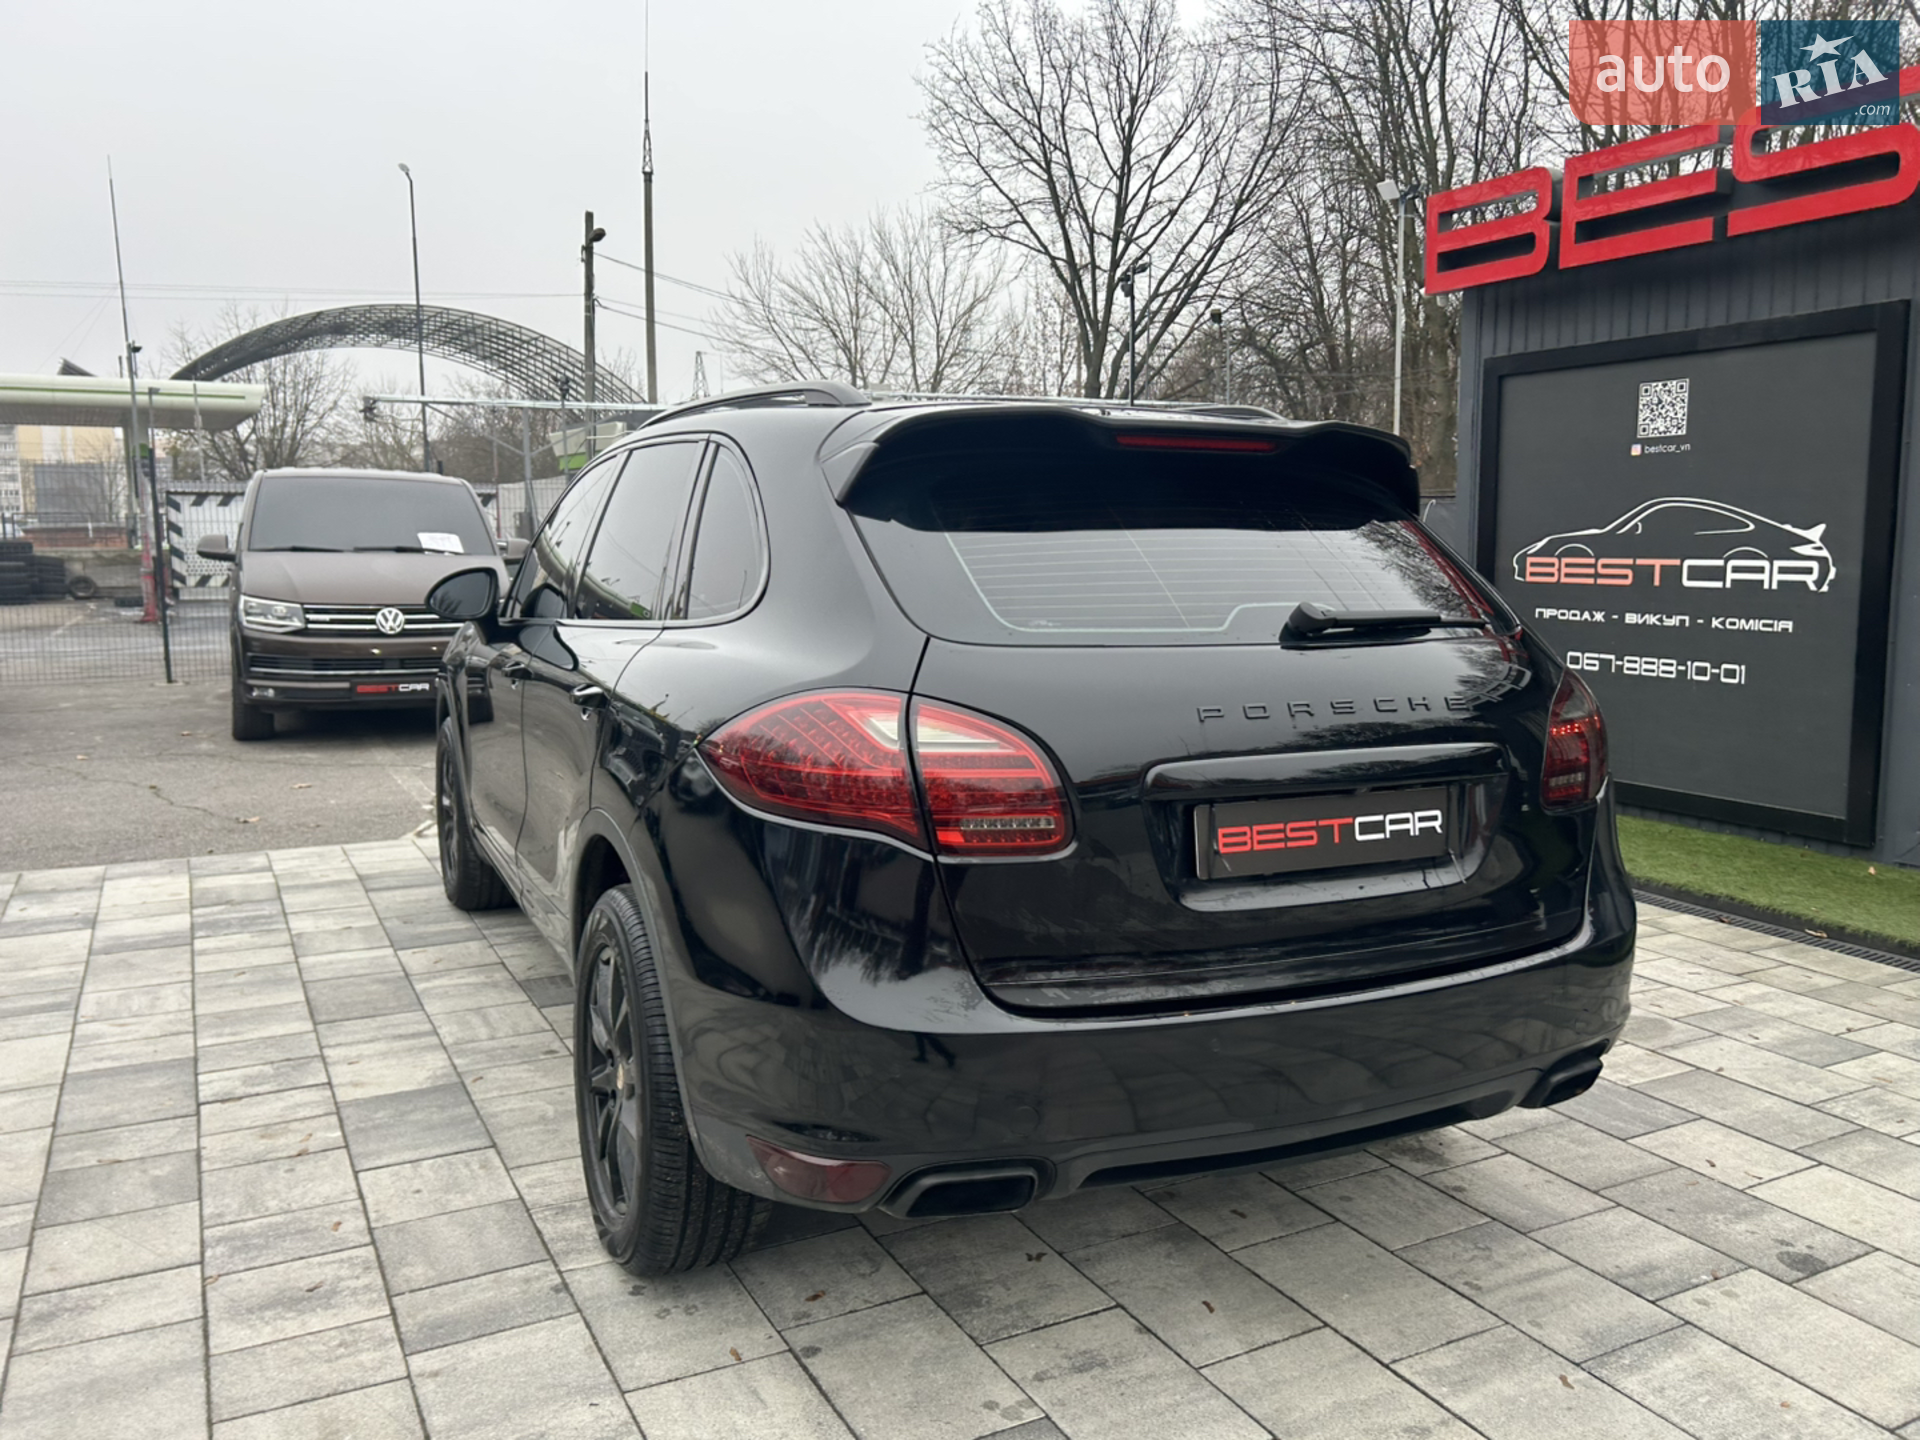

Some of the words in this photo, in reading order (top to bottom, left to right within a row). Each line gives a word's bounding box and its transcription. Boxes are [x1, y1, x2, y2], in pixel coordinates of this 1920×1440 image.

[1644, 443, 1692, 454] bestcar_vn
[1525, 556, 1820, 592] BESTCAR
[1535, 607, 1606, 623] ПРОДАЖ
[1624, 612, 1690, 627] ВИКУП
[1711, 616, 1794, 633] КОМІСІЯ
[1566, 651, 1746, 685] 067-888-10-01
[1197, 696, 1471, 723] PORSCHE
[1217, 809, 1443, 854] BESTCAR
